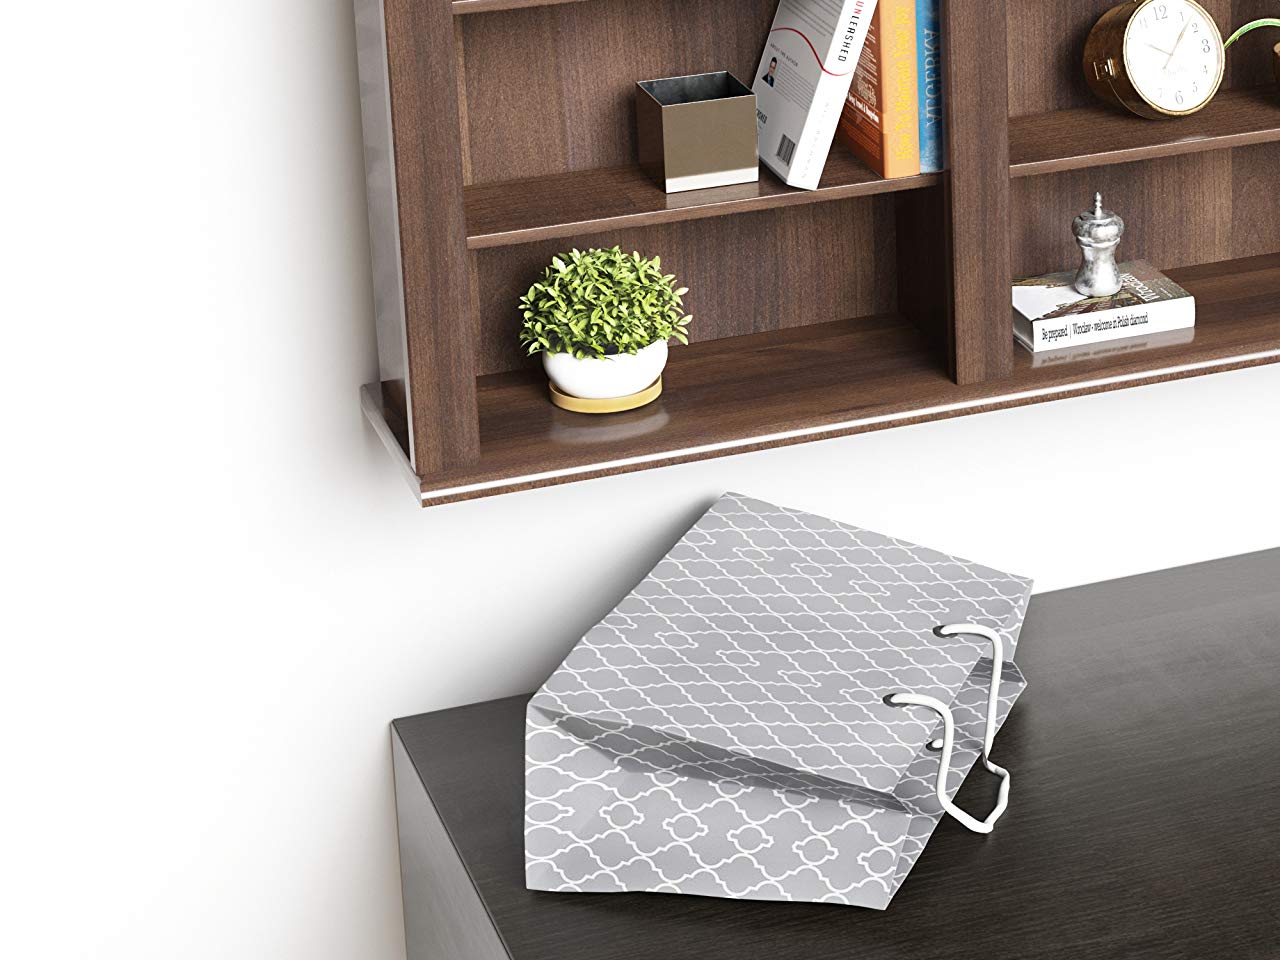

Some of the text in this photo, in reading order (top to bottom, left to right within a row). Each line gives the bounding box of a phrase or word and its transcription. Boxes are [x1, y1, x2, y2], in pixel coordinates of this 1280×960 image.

[1153, 4, 1168, 21] 12
[838, 0, 865, 63] UNLEASHED
[1191, 22, 1199, 33] 2
[1201, 38, 1211, 54] 3
[1175, 90, 1184, 105] 6
[1042, 327, 1048, 340] Be
[1048, 324, 1068, 342] prepared
[1094, 319, 1112, 331] welcome
[1130, 311, 1148, 326] diamond
